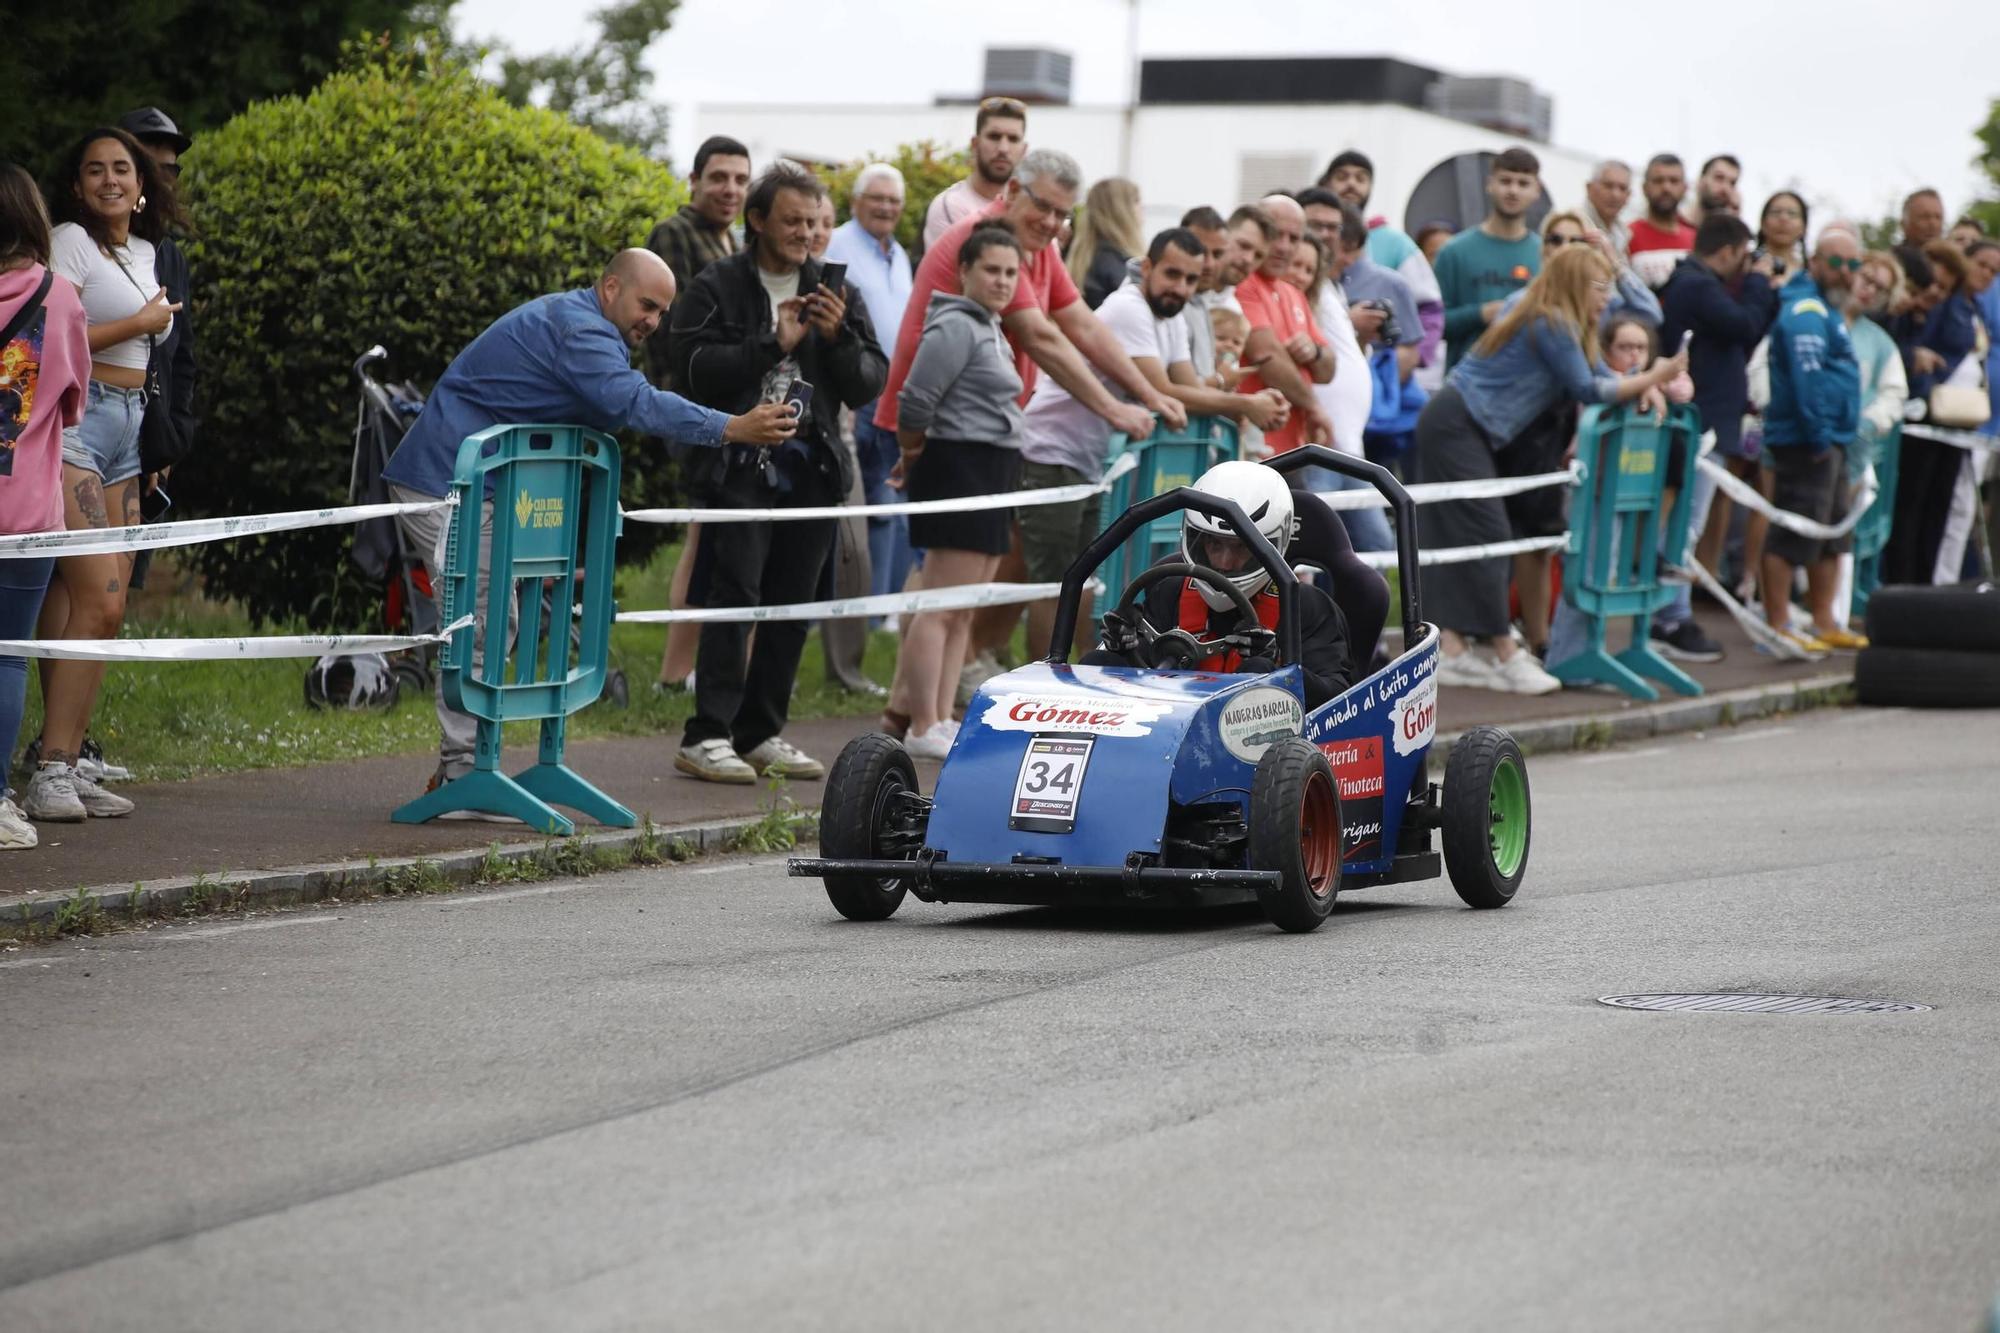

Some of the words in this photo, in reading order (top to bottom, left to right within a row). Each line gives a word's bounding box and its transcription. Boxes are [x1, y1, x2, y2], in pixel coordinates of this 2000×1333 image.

[1009, 701, 1129, 727] Gómez
[1225, 705, 1262, 726] MADERAS
[1262, 700, 1291, 719] BARCIA
[1306, 721, 1320, 741] sin
[1325, 697, 1358, 731] miedo
[1363, 686, 1375, 711] al
[1380, 669, 1408, 702] éxito
[1365, 743, 1375, 759] &
[1025, 761, 1075, 794] 34
